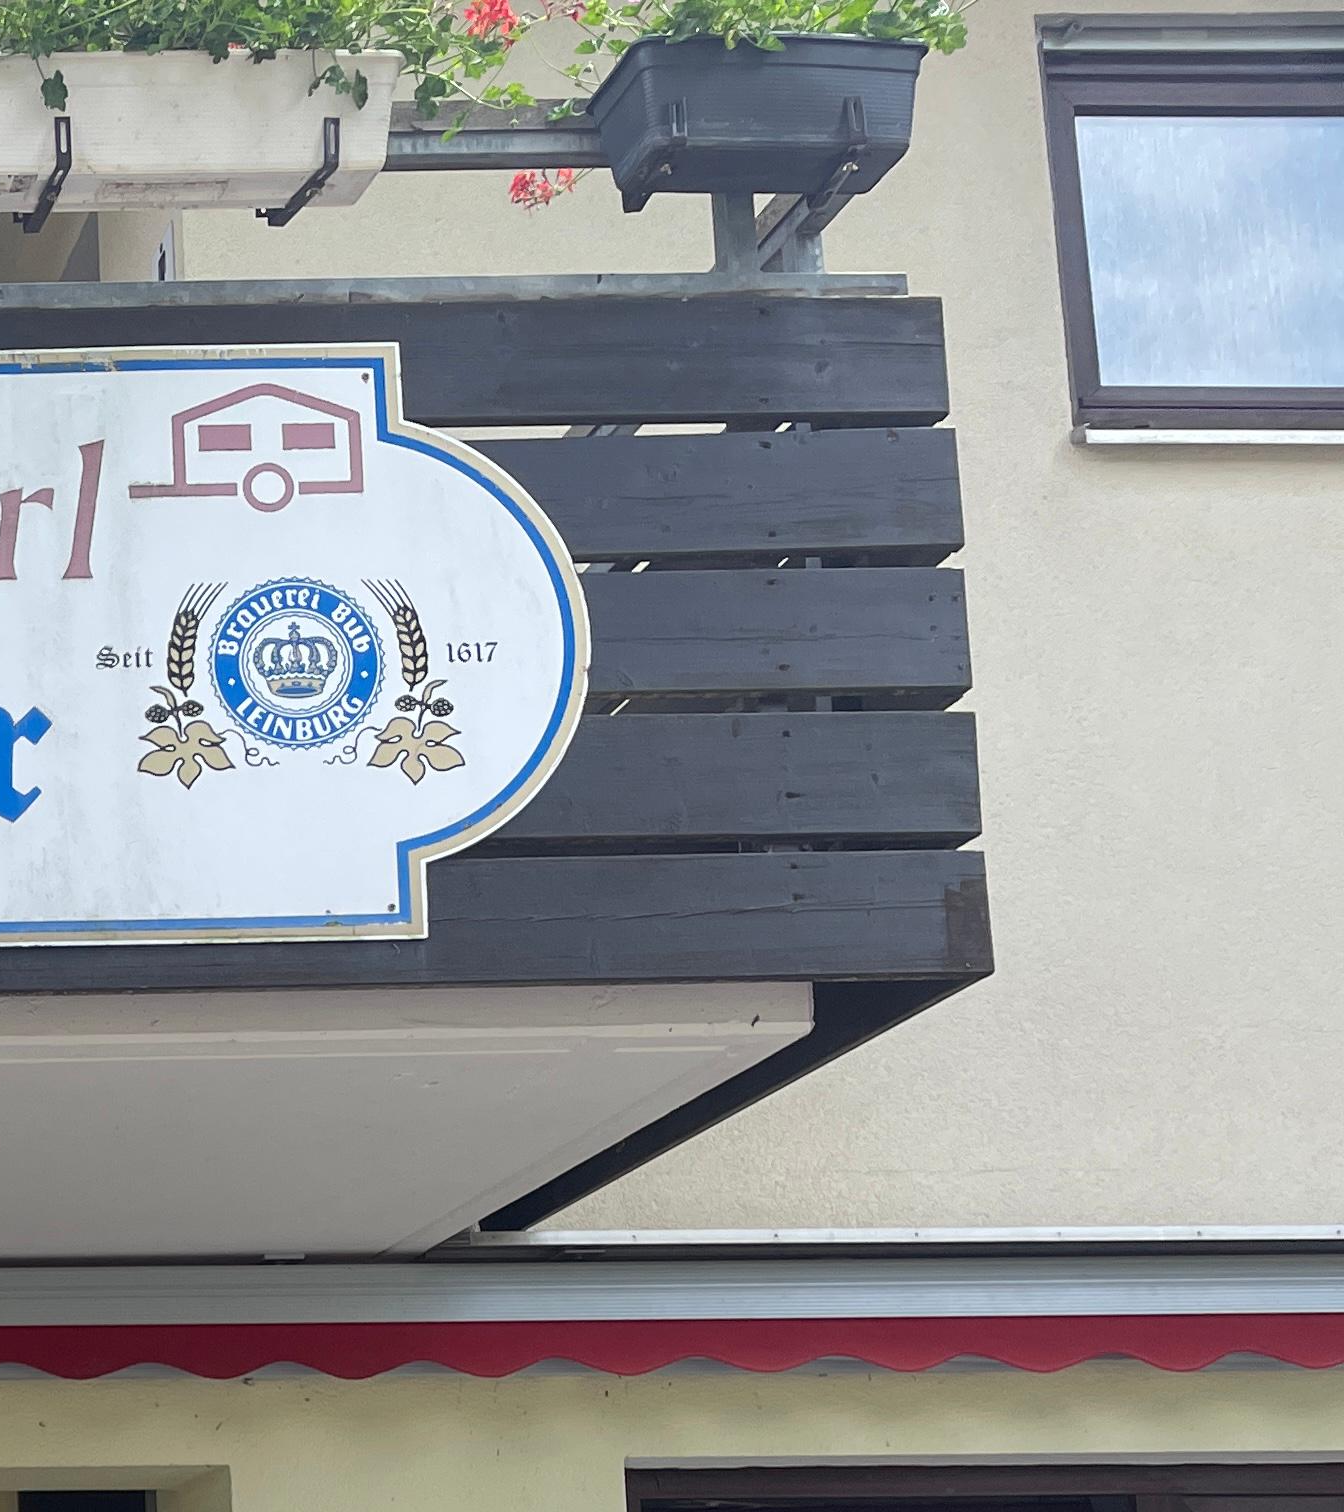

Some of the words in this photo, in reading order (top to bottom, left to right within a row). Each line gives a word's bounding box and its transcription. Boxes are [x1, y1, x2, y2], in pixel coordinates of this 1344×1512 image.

[218, 587, 320, 656] Brauerei
[330, 603, 371, 655] Bub
[95, 646, 154, 670] Seit
[446, 642, 499, 663] 1617
[234, 692, 364, 741] LEINBURG
